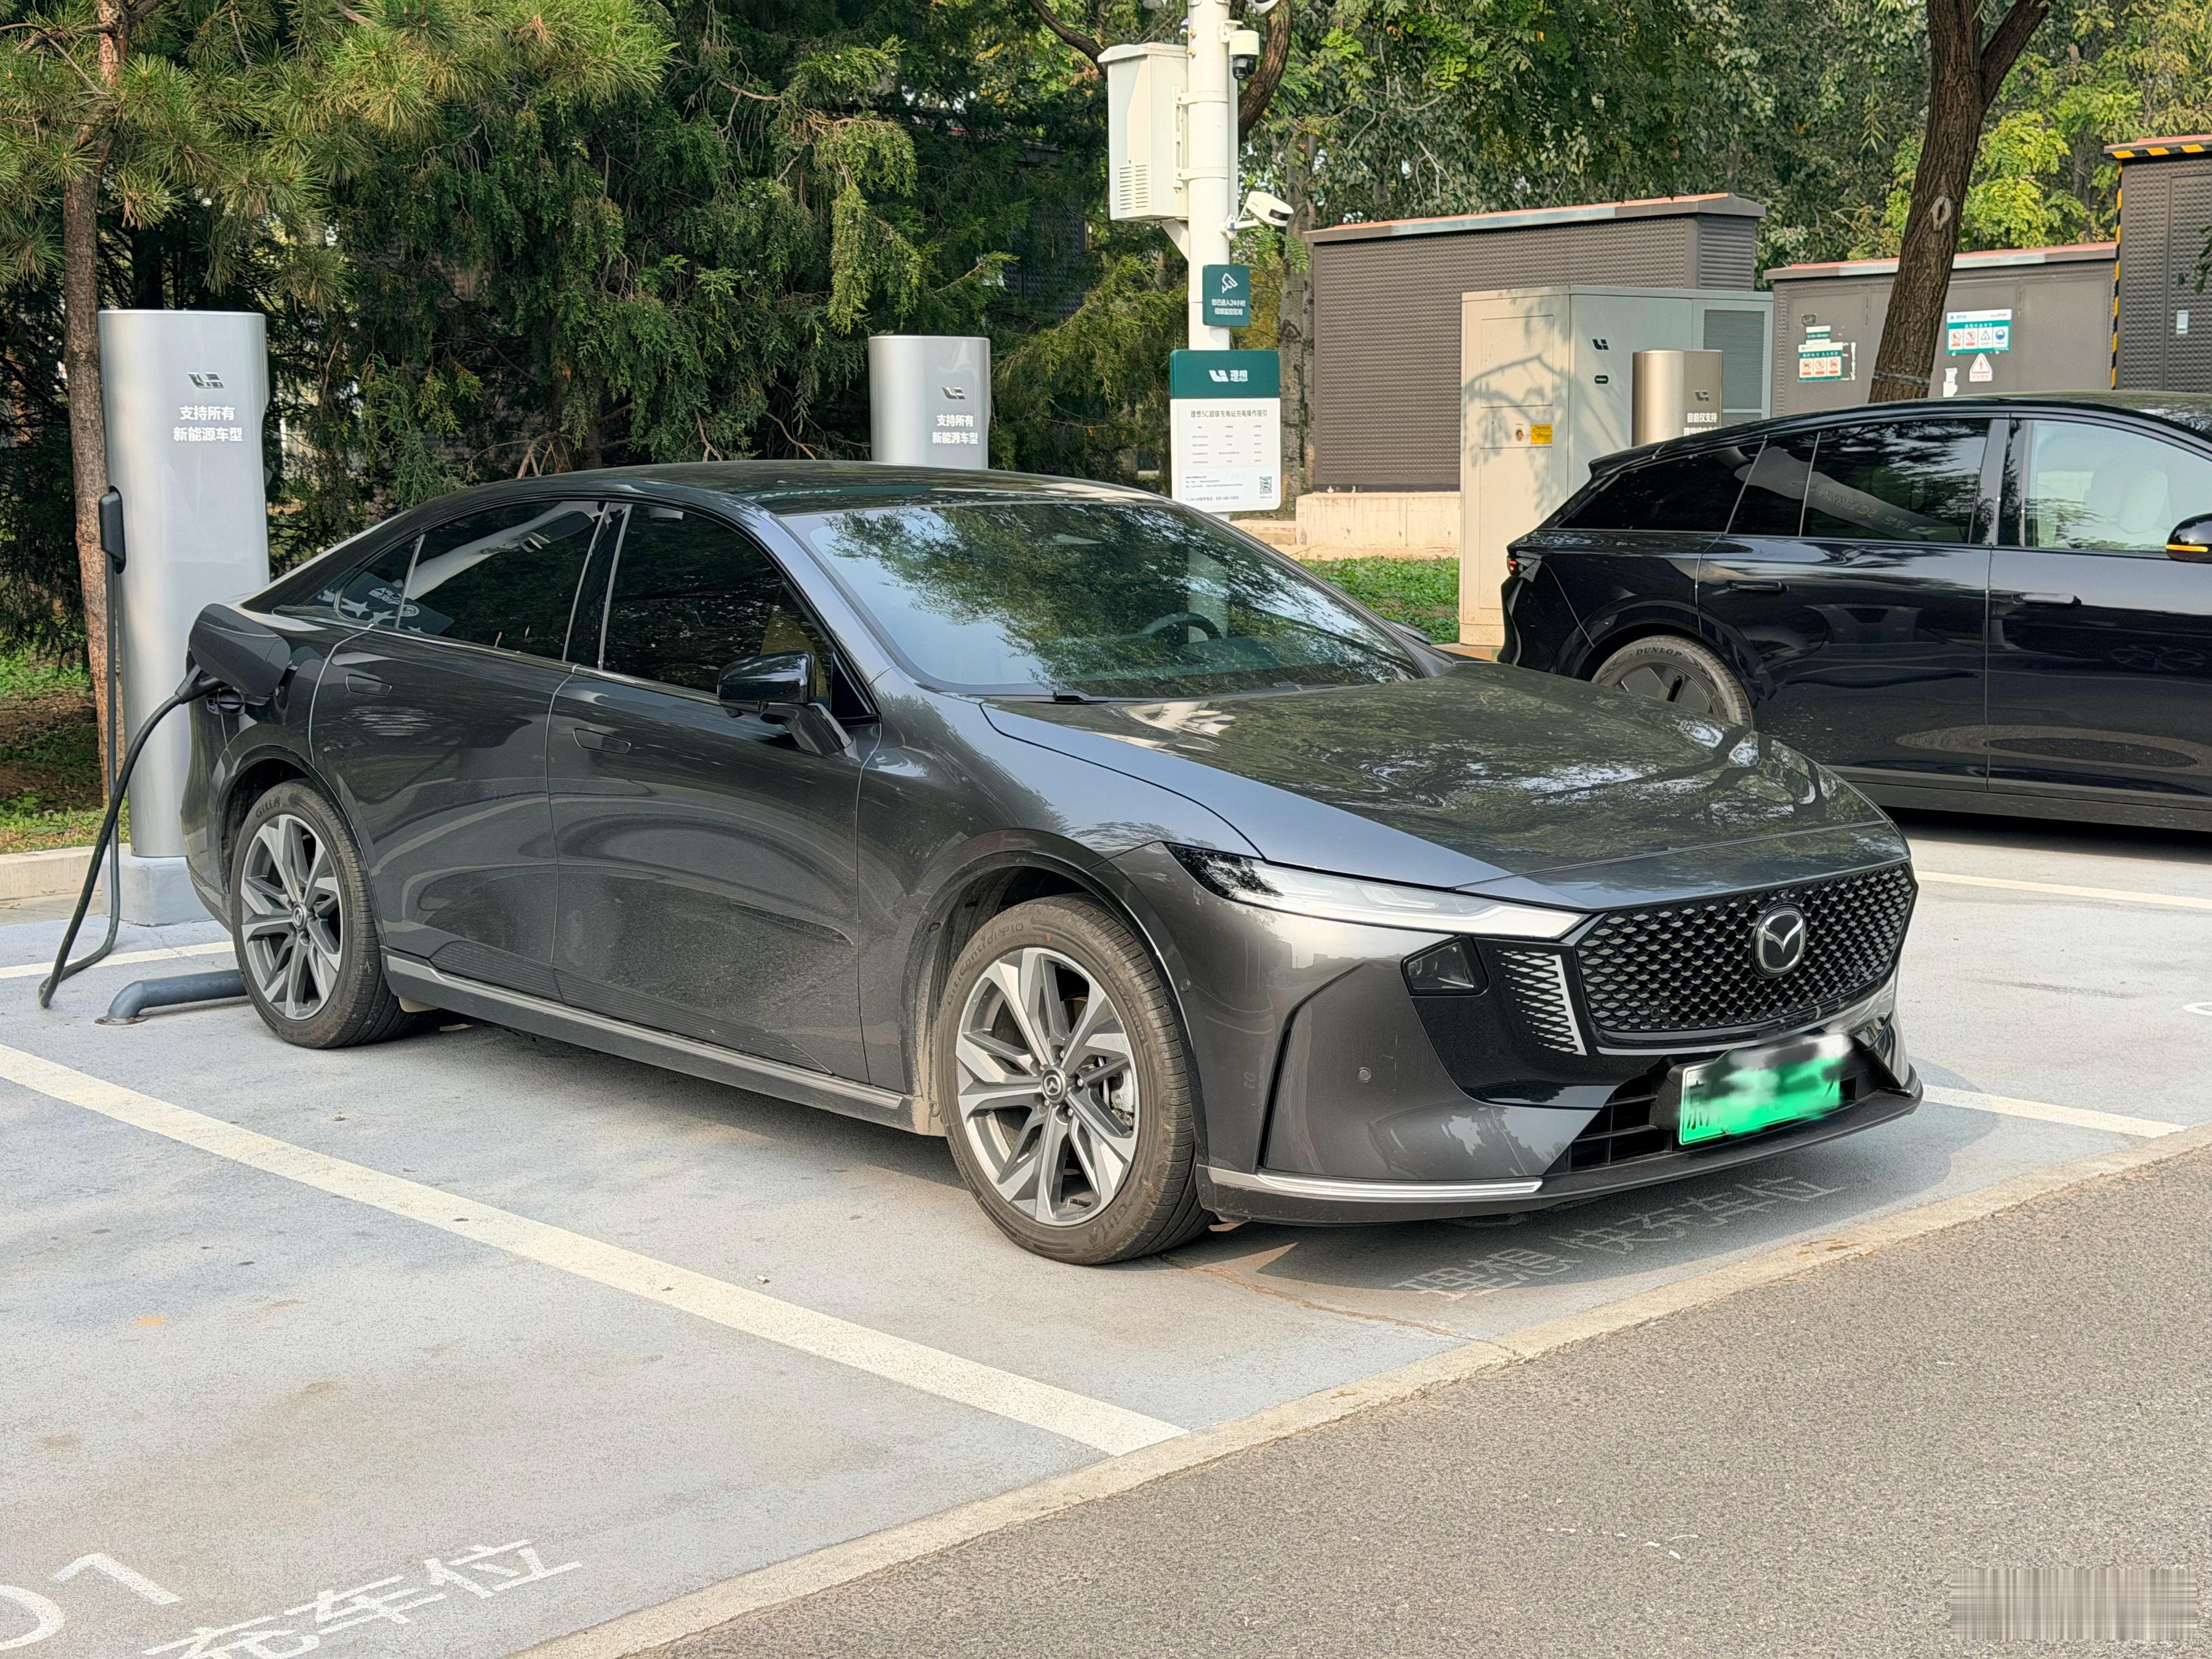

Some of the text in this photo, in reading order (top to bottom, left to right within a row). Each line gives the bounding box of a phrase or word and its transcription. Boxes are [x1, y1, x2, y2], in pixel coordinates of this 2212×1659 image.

[1230, 369, 1249, 382] 理想
[179, 406, 235, 421] 支持所有
[1687, 413, 1718, 423] 目前仅支持
[936, 414, 974, 427] 支持所有
[173, 426, 242, 442] 新能源车型
[932, 432, 979, 444] 新能源车型
[1636, 647, 1683, 657] DUNLOP
[1549, 1177, 1847, 1255] 快充车位
[1392, 1249, 1582, 1301] 理想
